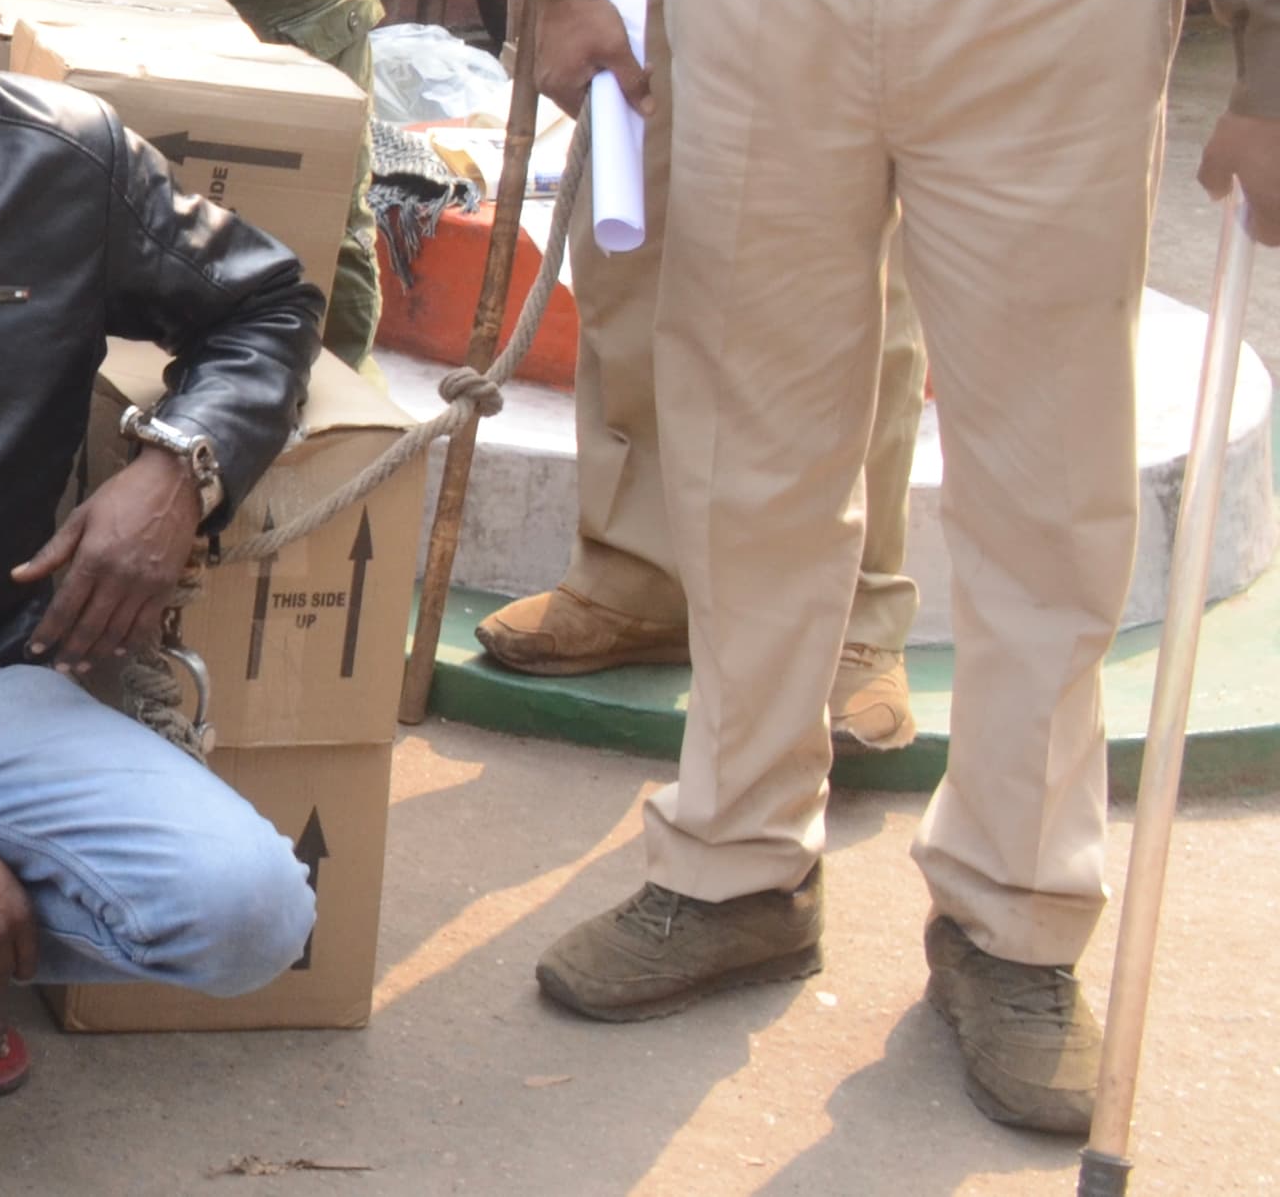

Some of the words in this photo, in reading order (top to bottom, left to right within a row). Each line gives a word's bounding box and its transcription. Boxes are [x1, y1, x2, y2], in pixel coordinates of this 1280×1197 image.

[208, 166, 228, 203] IDE
[271, 592, 307, 609] THIS
[311, 591, 346, 608] SIDE
[295, 613, 318, 629] UP
